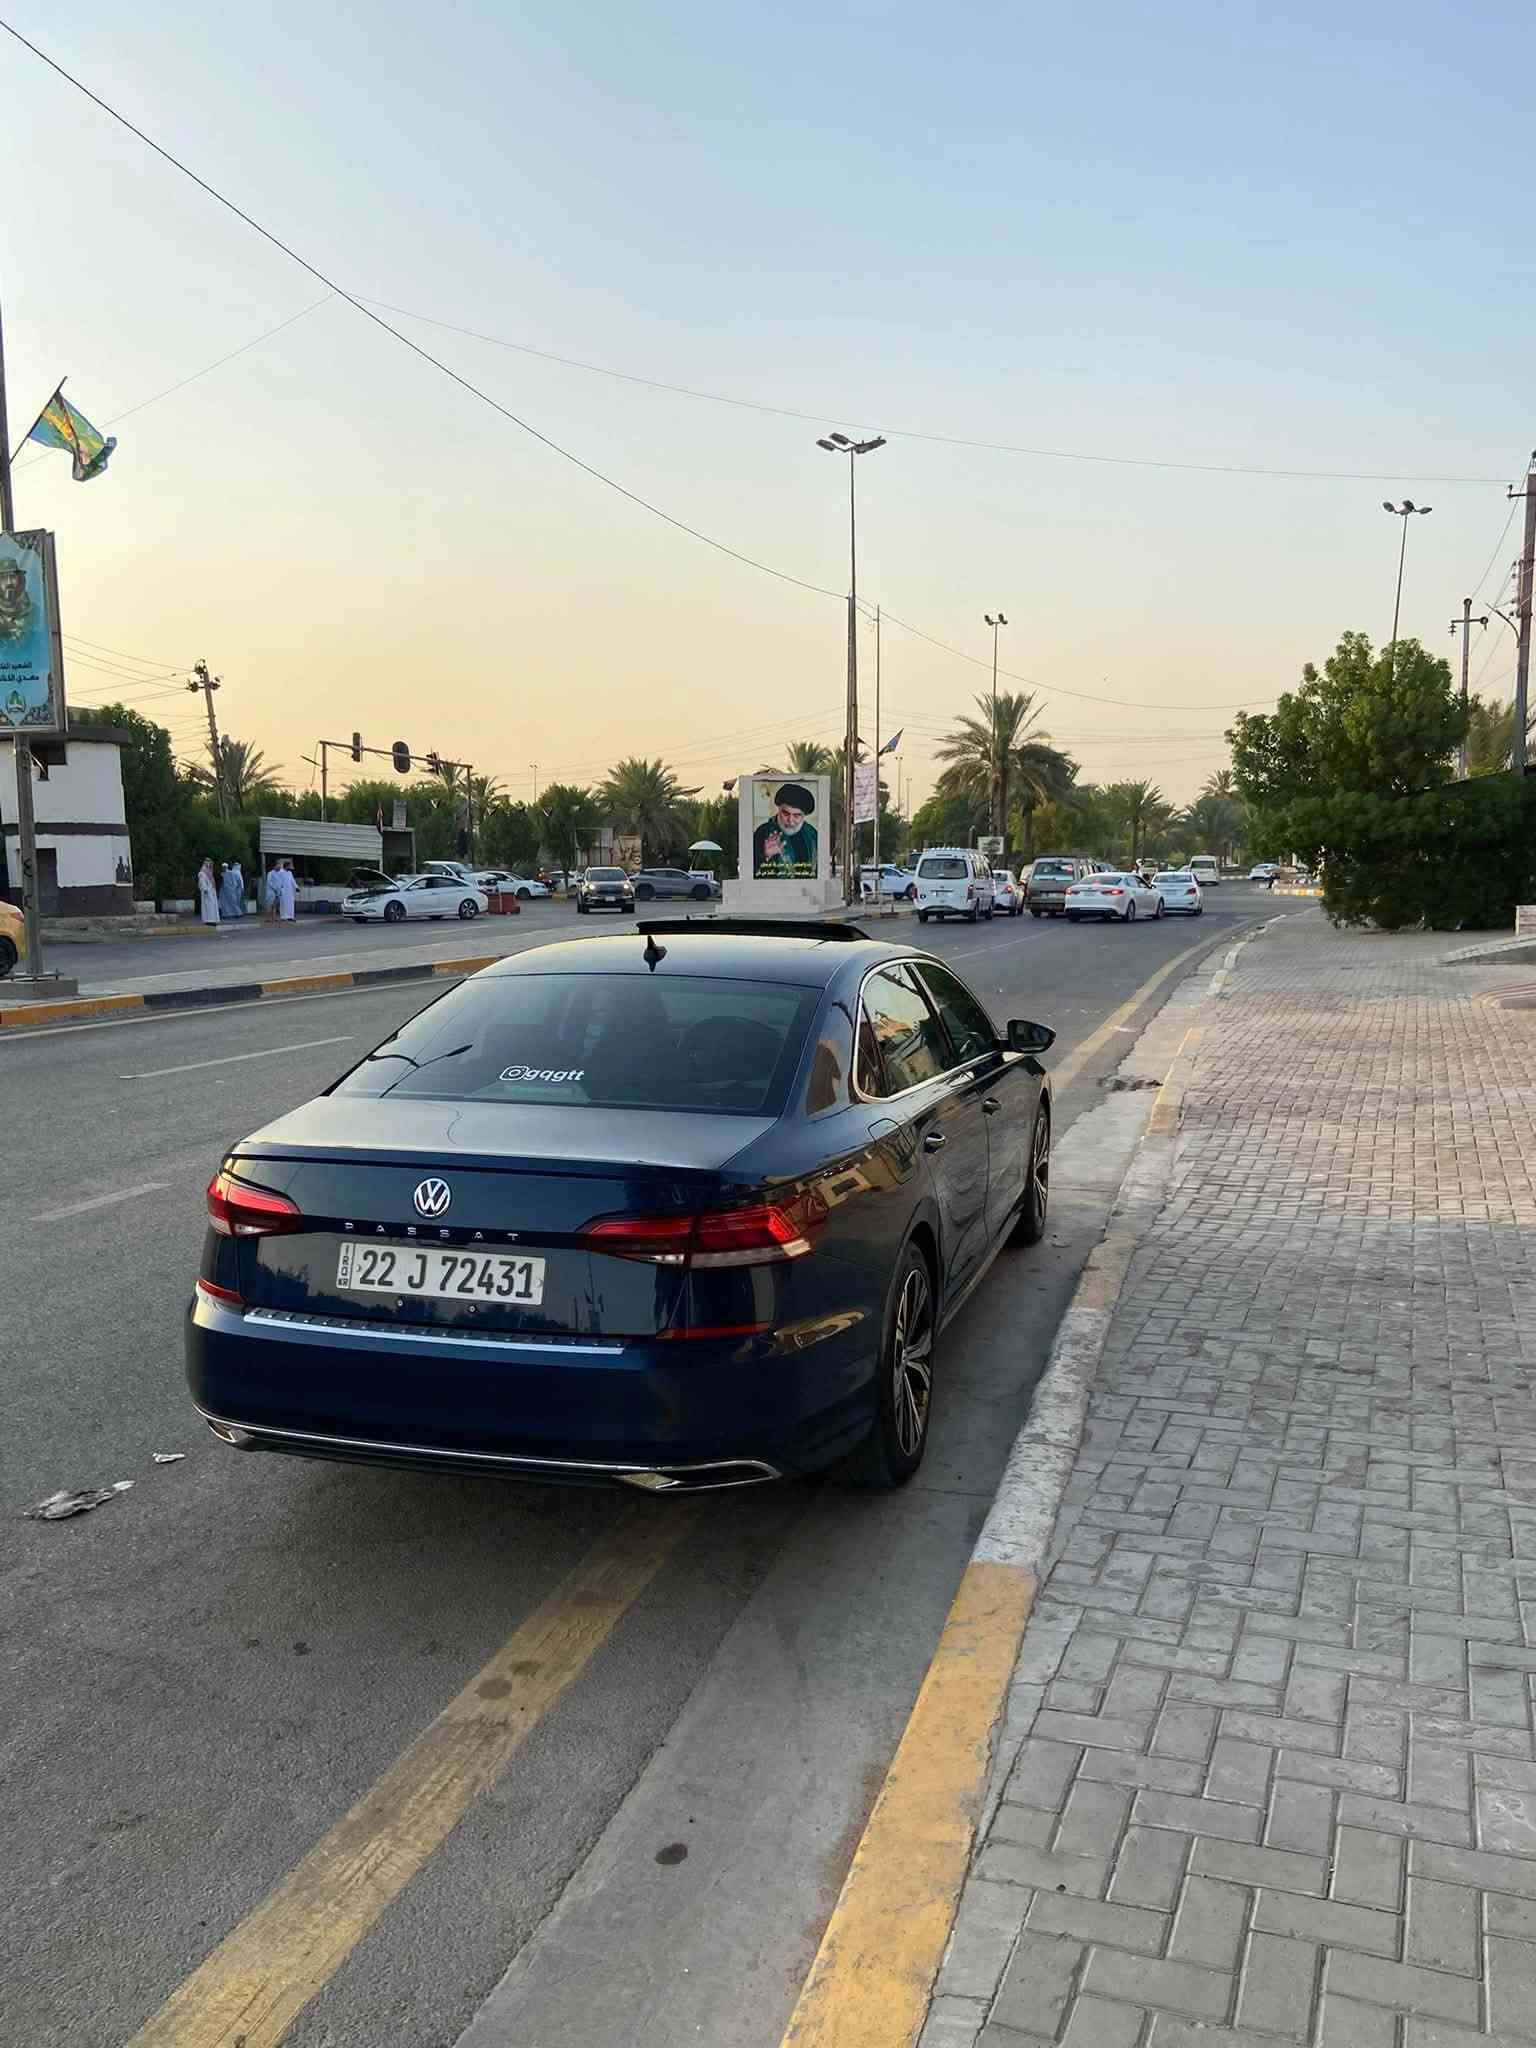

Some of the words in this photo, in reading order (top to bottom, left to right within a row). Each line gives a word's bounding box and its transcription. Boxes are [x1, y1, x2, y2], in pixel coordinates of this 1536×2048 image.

[414, 1178, 451, 1217] VW
[344, 1222, 519, 1241] PASSAT
[359, 1250, 397, 1287] 22
[407, 1253, 428, 1289] J
[439, 1255, 534, 1298] 72431
